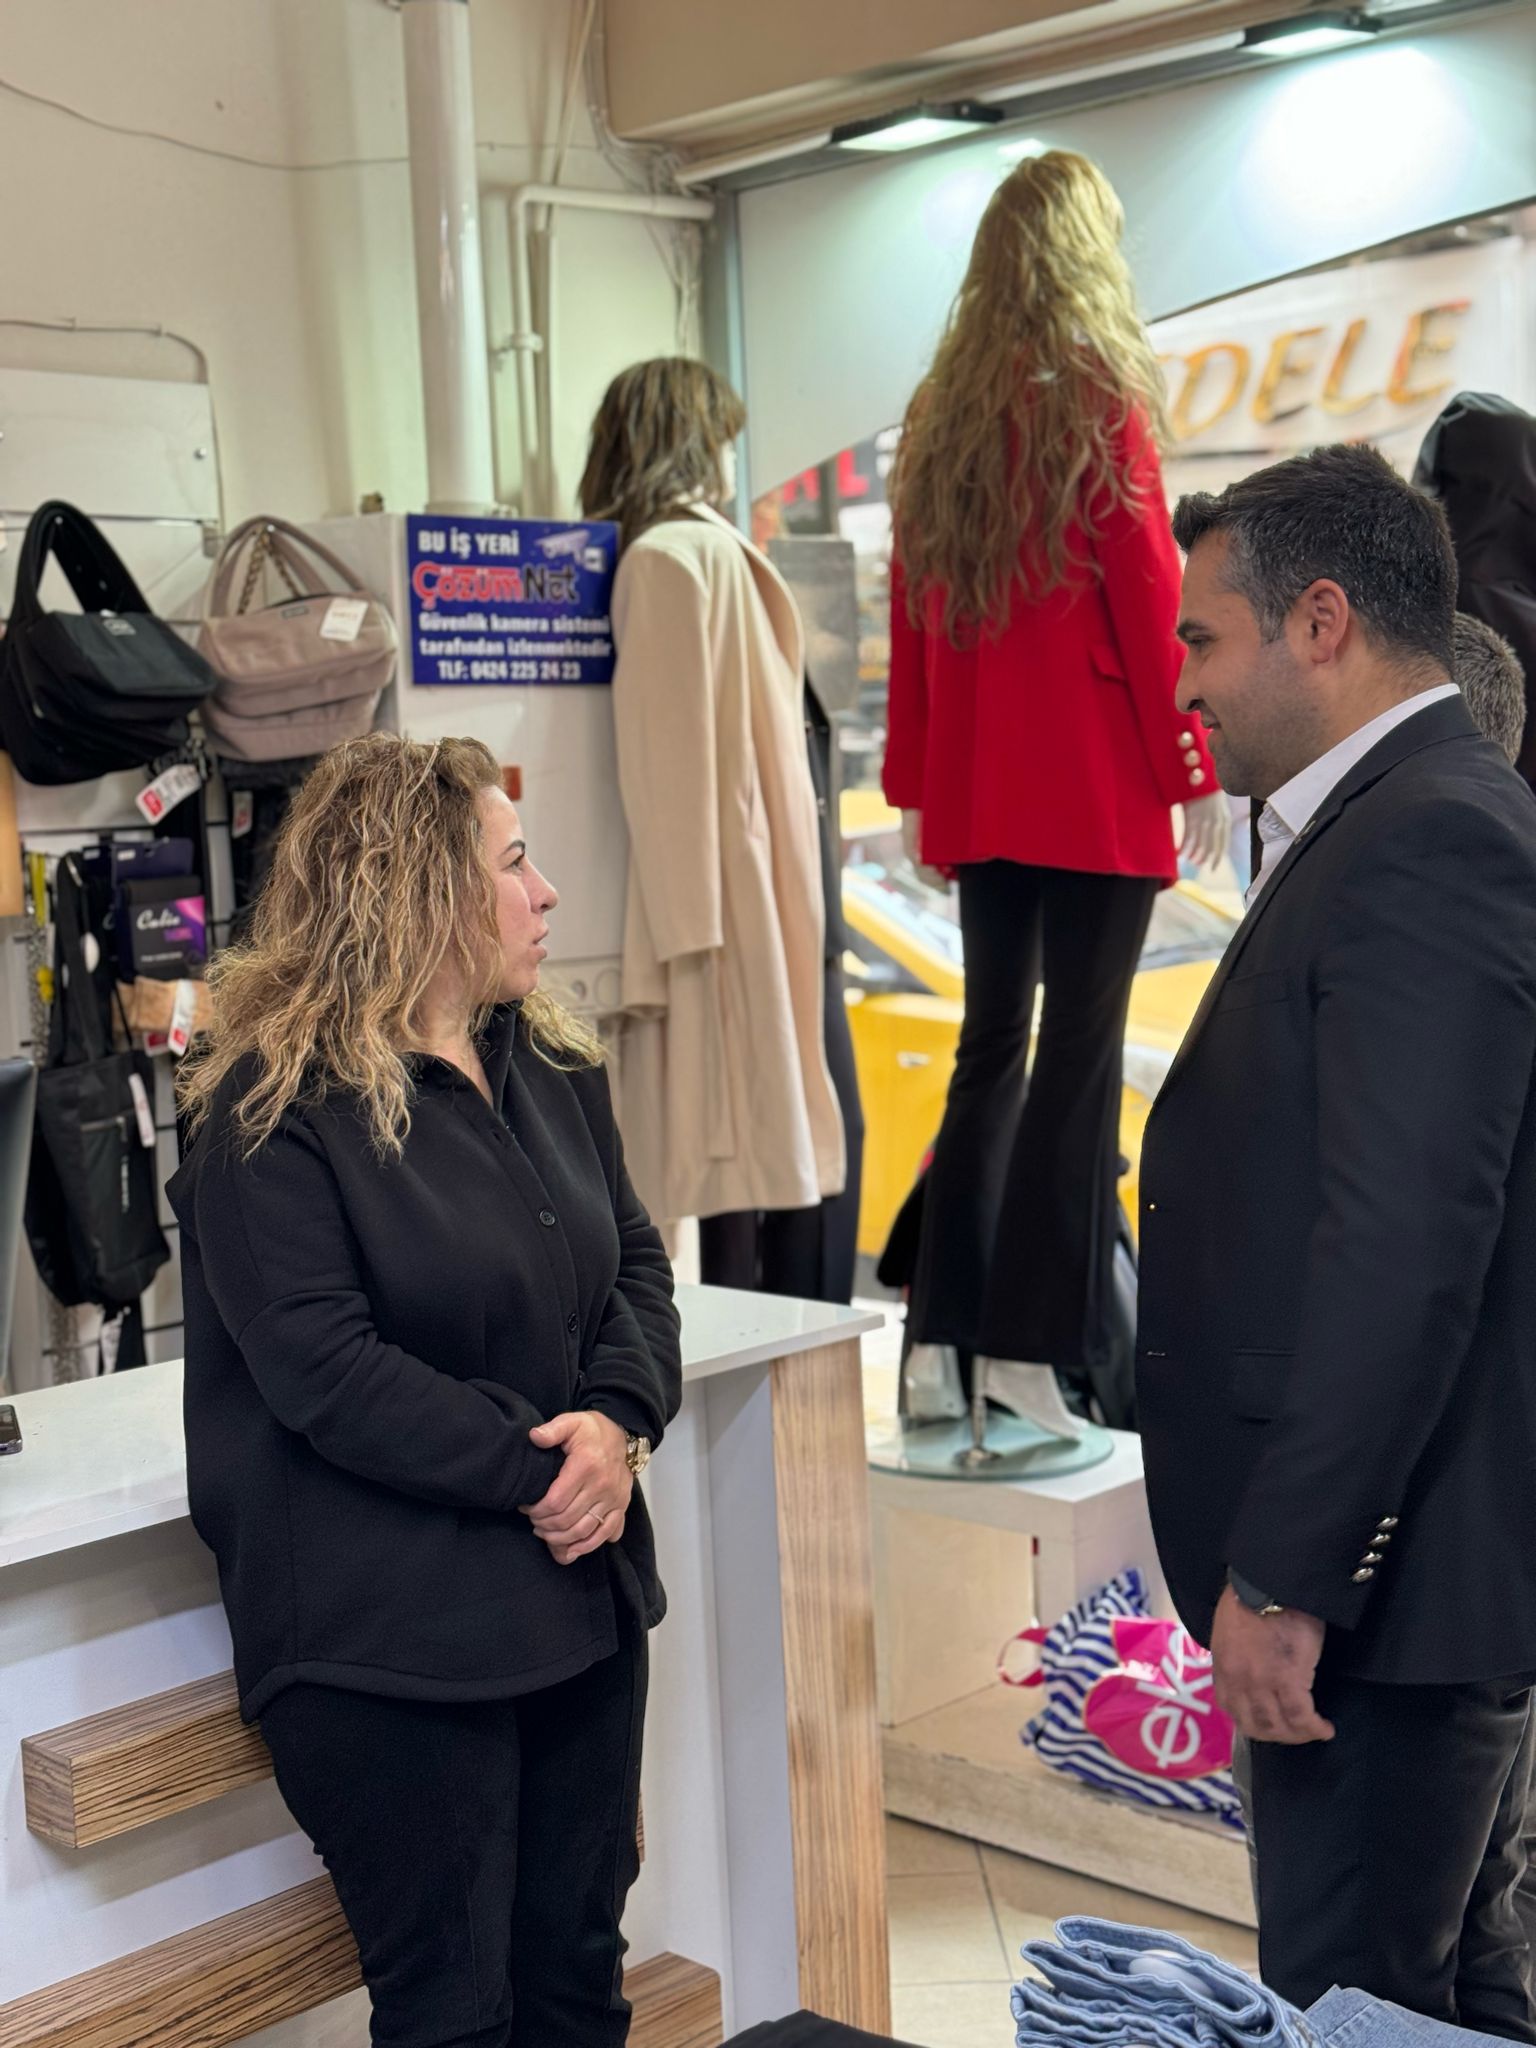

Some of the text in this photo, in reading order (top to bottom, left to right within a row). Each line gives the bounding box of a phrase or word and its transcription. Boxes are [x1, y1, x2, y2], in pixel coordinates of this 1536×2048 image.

[1157, 297, 1473, 443] DELE
[418, 527, 520, 559] BU İŞ YERİ
[490, 613, 549, 632] kamera
[437, 660, 468, 680] TLF:
